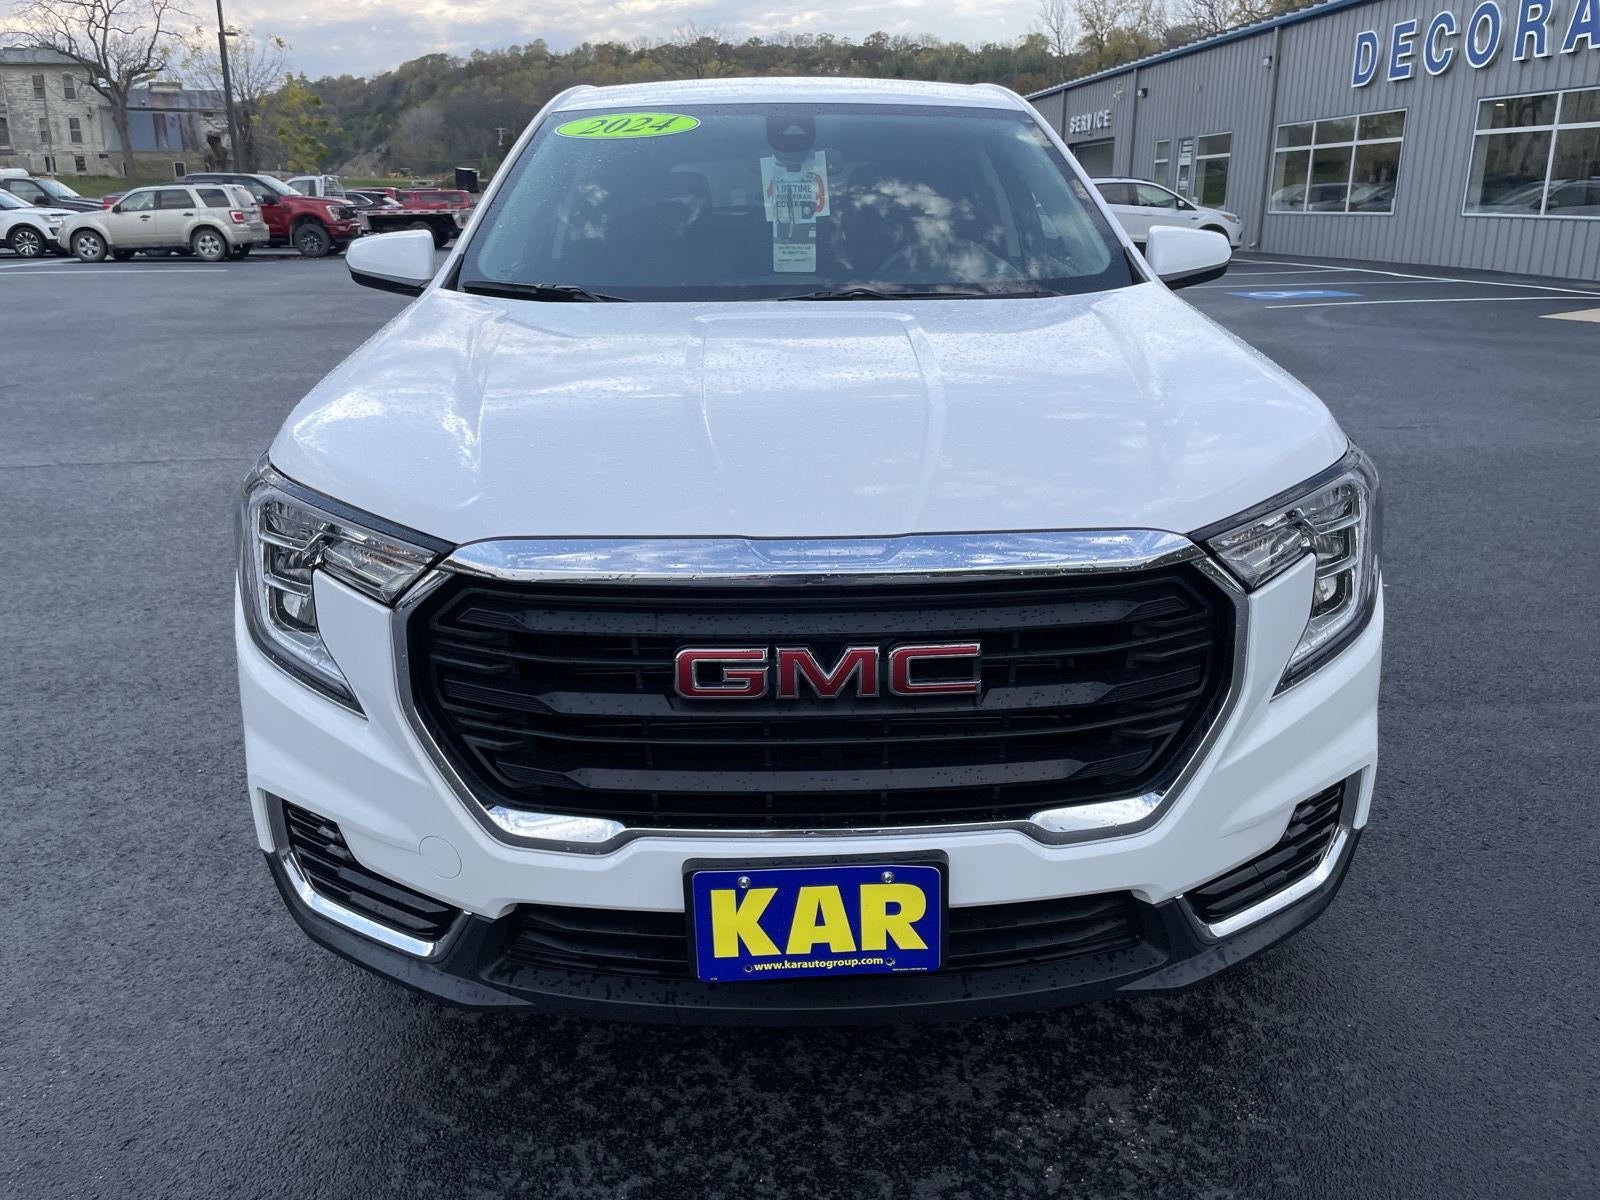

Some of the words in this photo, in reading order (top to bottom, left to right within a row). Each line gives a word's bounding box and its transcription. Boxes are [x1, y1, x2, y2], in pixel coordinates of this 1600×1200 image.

[1350, 0, 1600, 88] DECORA
[577, 116, 680, 135] 2024
[1069, 109, 1111, 133] SERVICE
[776, 184, 812, 193] LIFETIME
[674, 642, 981, 699] GMC
[710, 883, 928, 958] KAR
[754, 957, 884, 971] www.karautogroup.com
